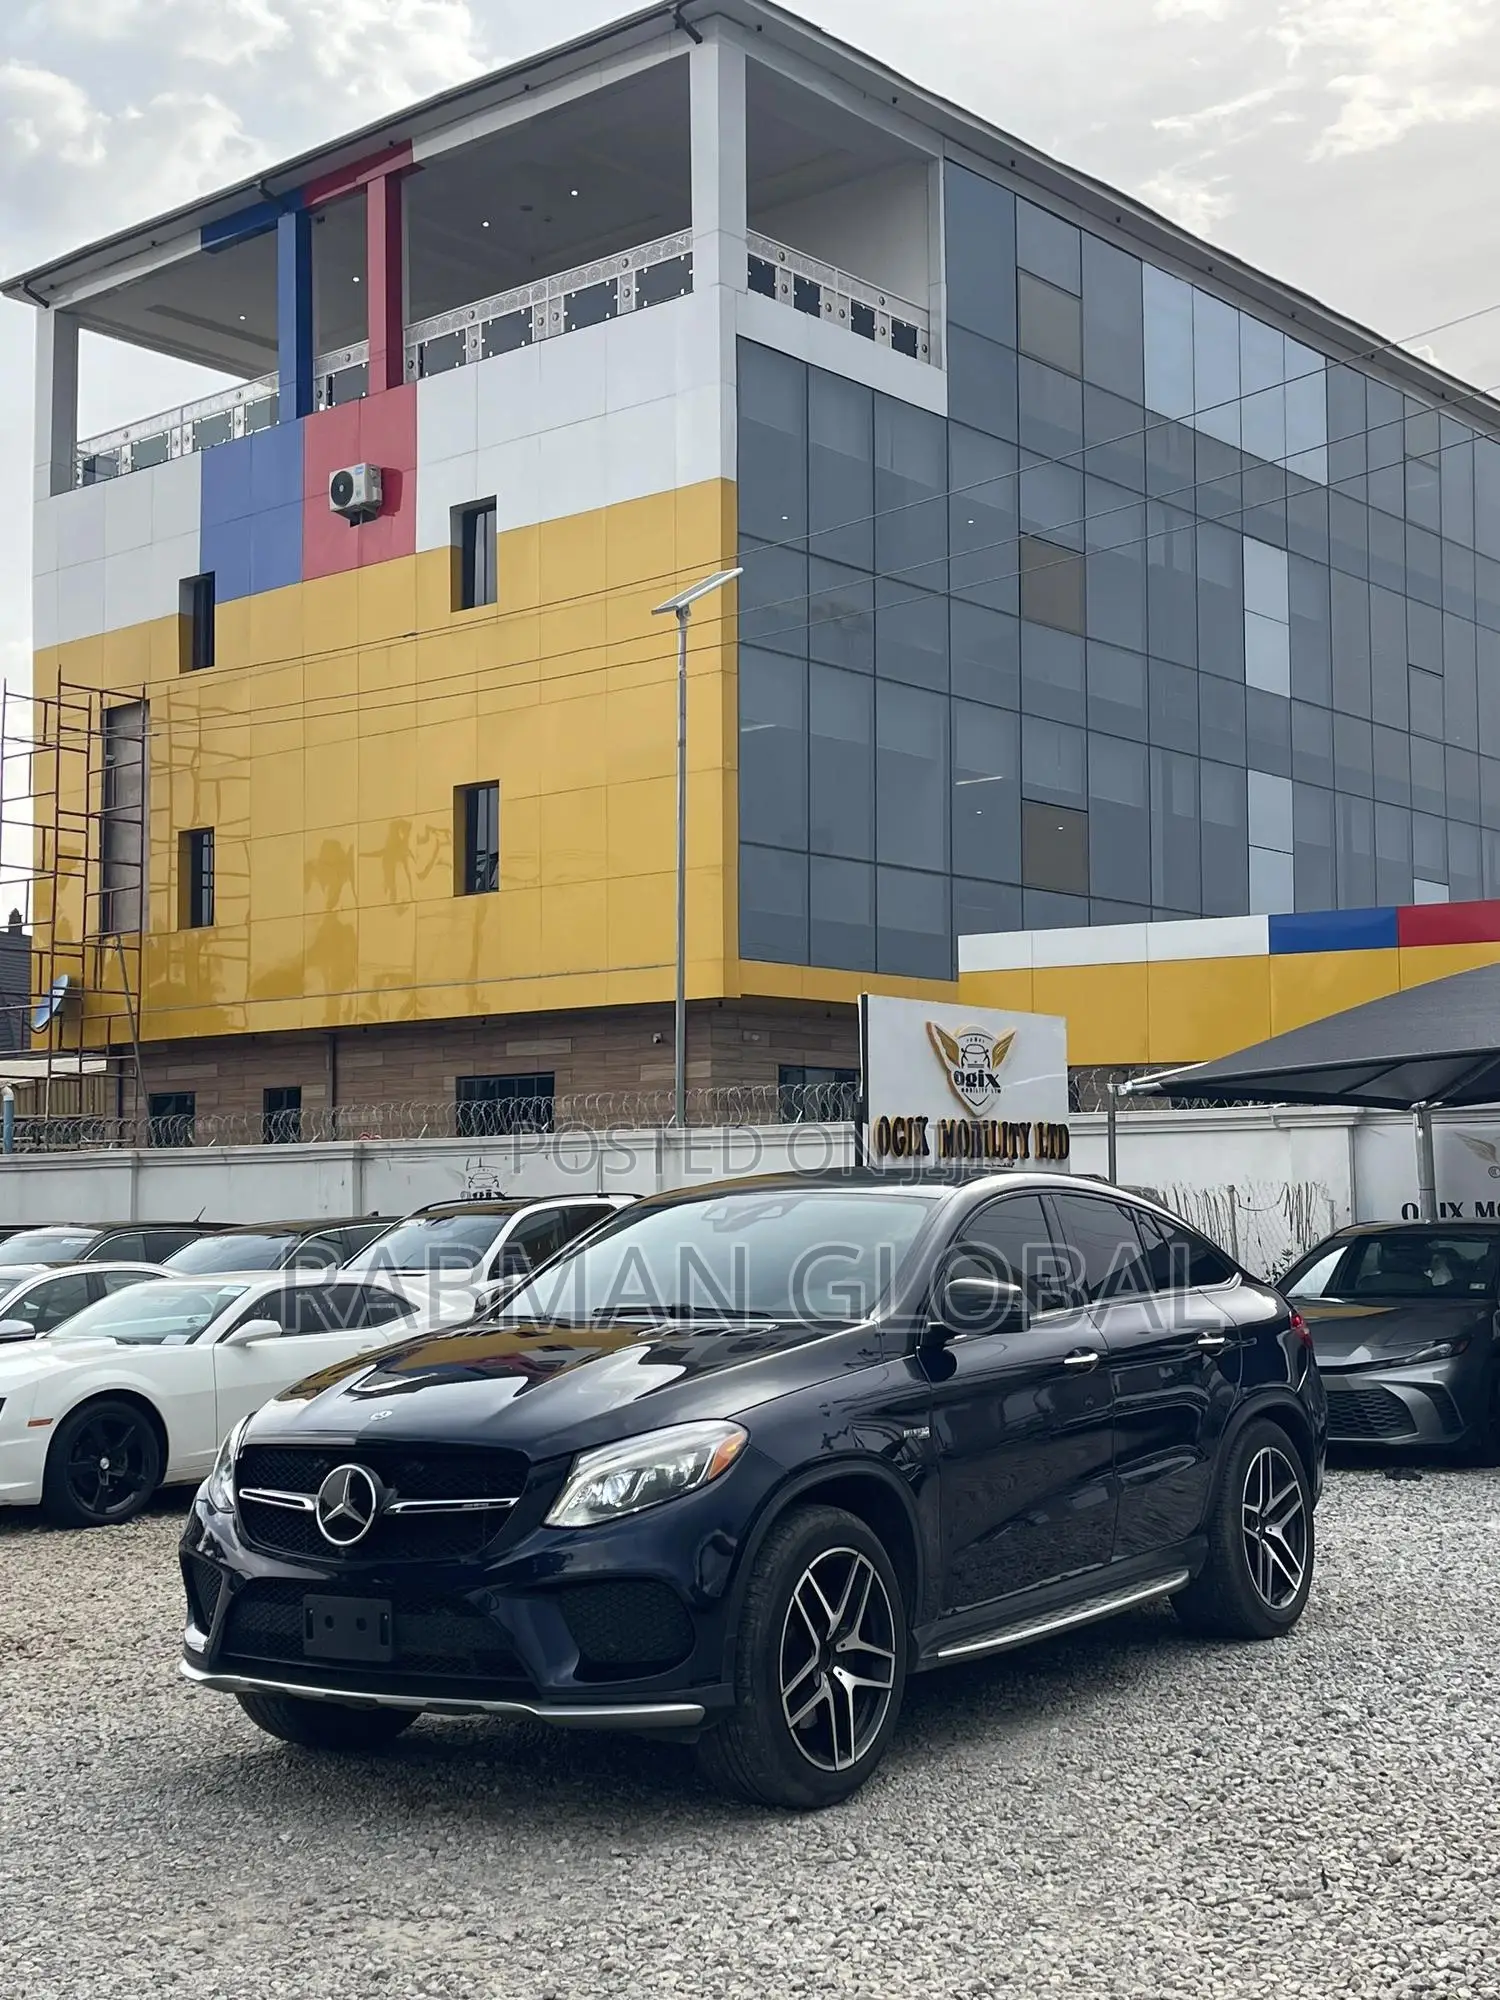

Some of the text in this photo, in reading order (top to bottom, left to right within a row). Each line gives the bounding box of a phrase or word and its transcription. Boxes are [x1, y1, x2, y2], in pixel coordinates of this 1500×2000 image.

[874, 1115, 930, 1158] OGIX
[1034, 1121, 1071, 1161] LTD
[1402, 1201, 1464, 1220] OIX
